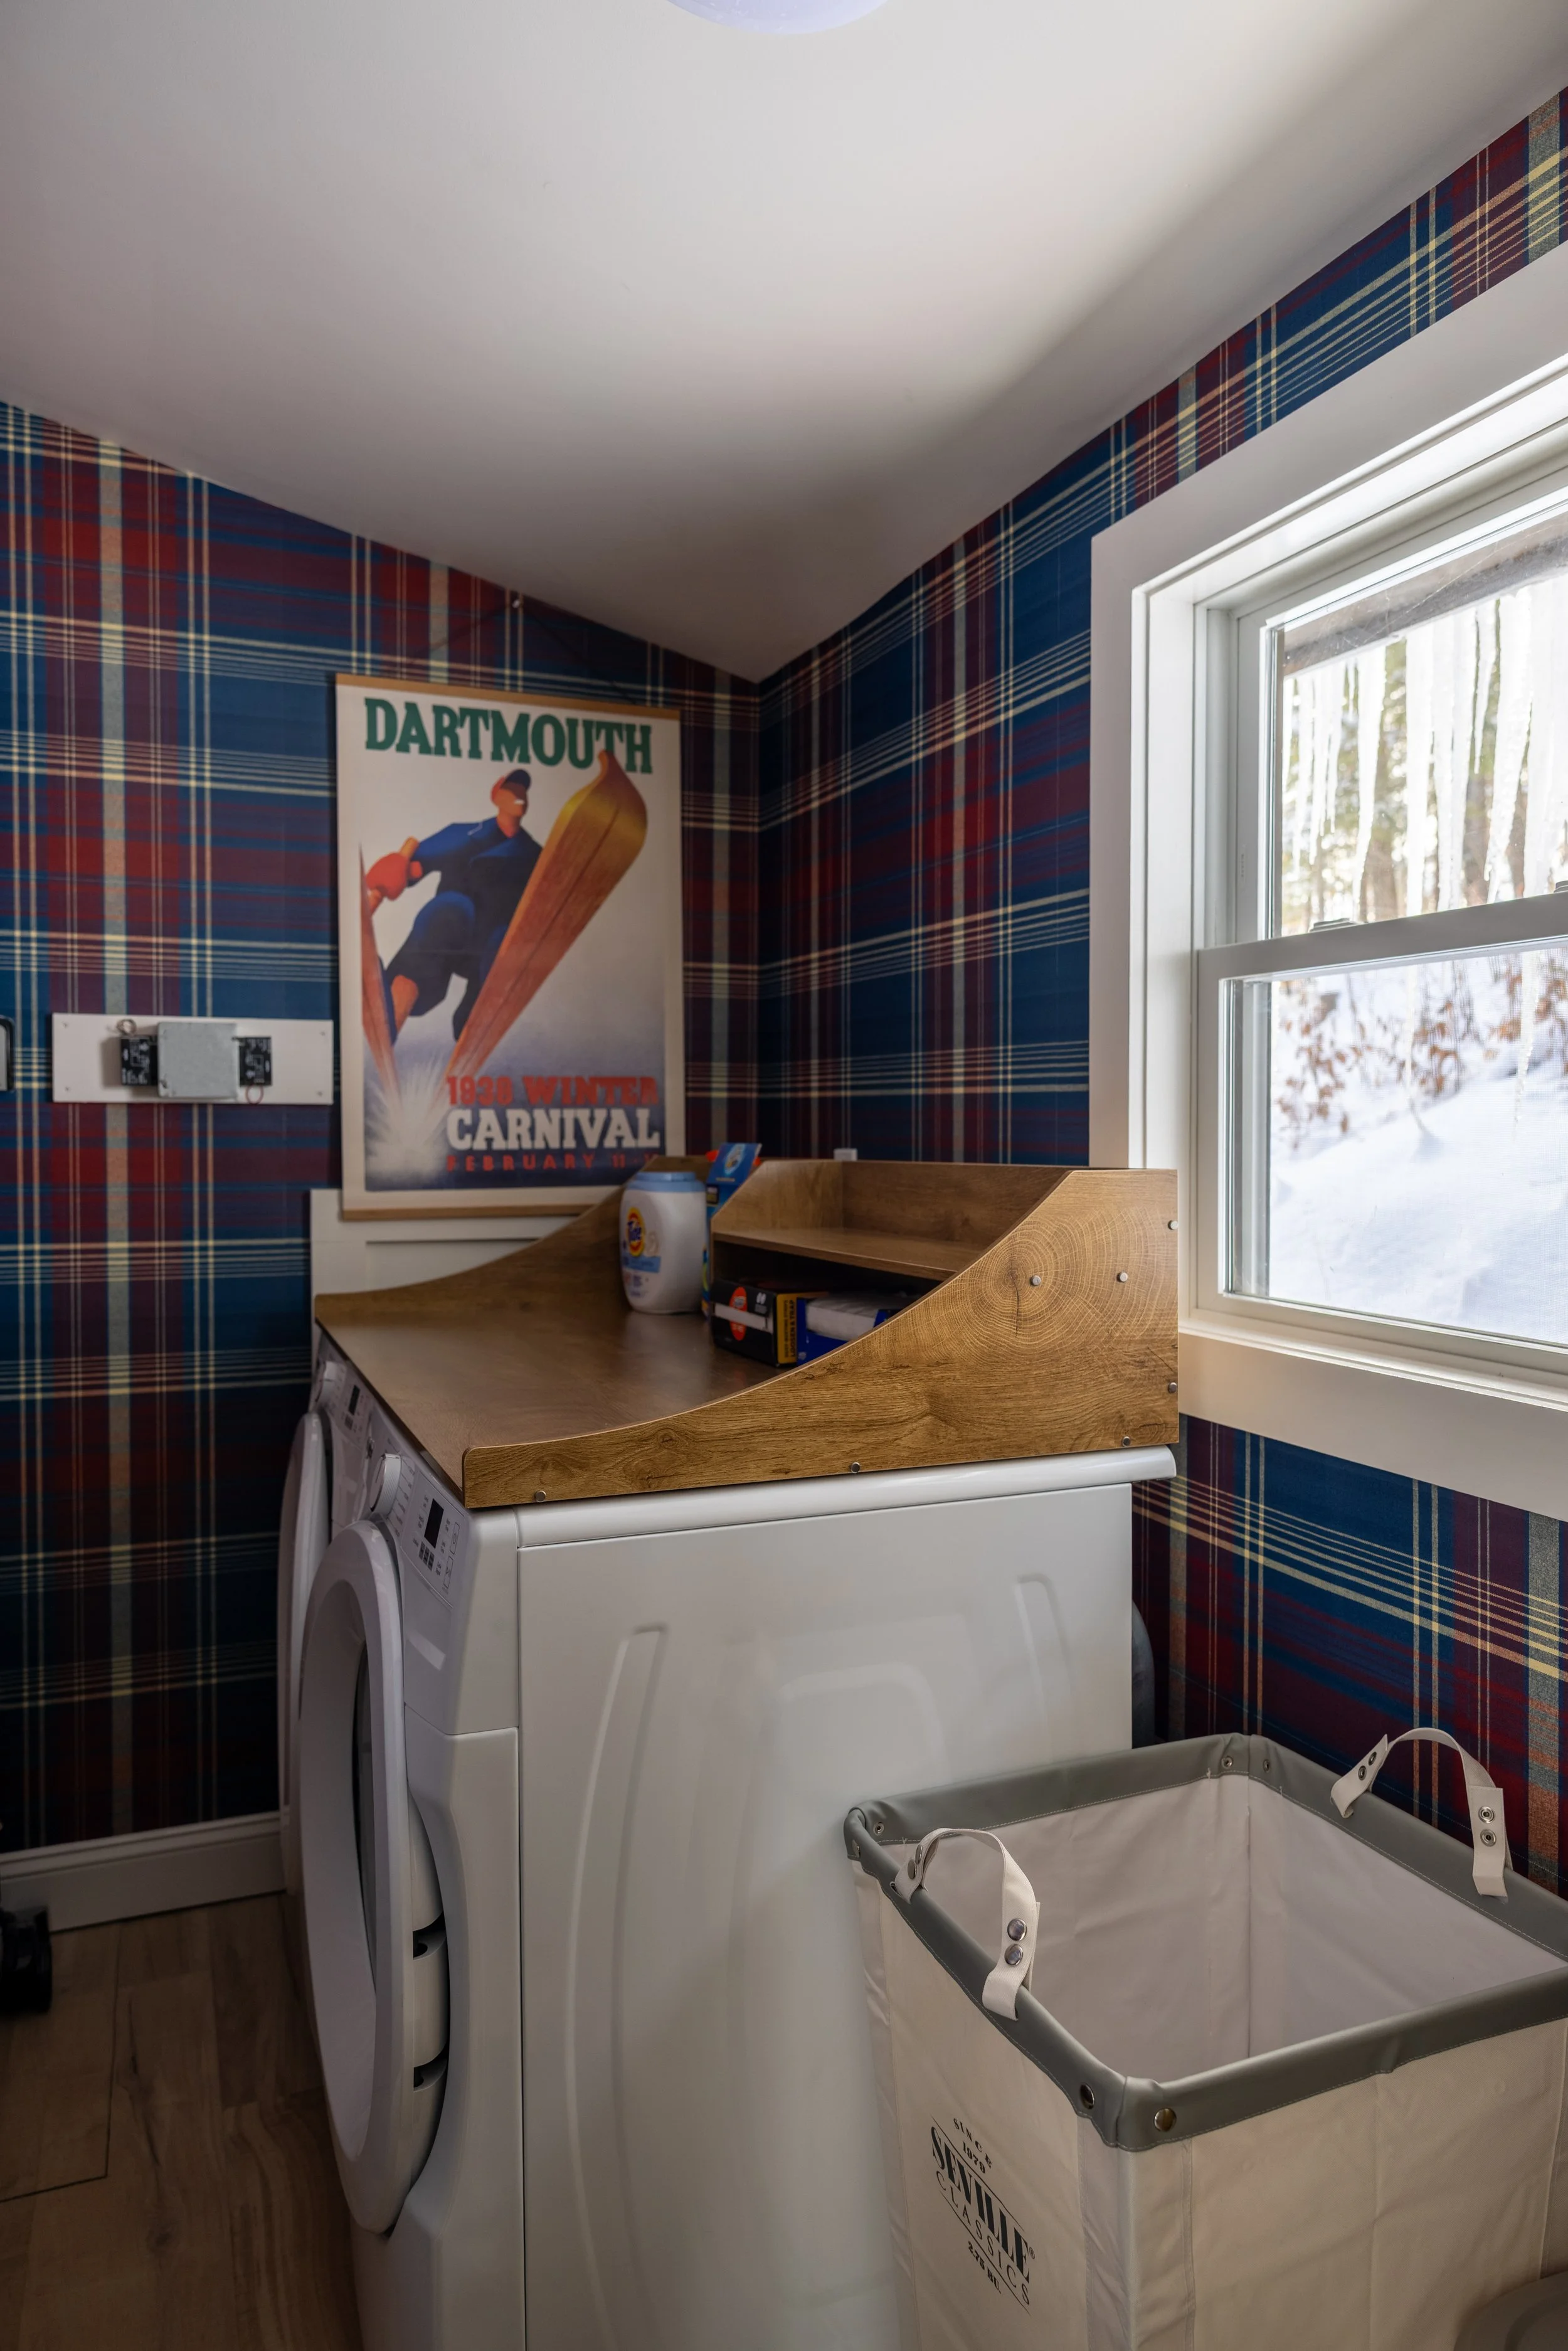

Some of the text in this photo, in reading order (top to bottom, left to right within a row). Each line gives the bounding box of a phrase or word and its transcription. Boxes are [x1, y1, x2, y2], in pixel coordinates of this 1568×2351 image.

[364, 697, 652, 773] DARTMOUTH
[447, 1075, 658, 1106] 1938 WINTER
[446, 1108, 660, 1150] CARNIVAL
[446, 1152, 595, 1172] FEBRUARY
[953, 2118, 992, 2168] SINCE
[962, 2140, 986, 2174] 1979
[936, 2170, 1030, 2306] CLASSICS
[968, 2240, 985, 2271] 2.75
